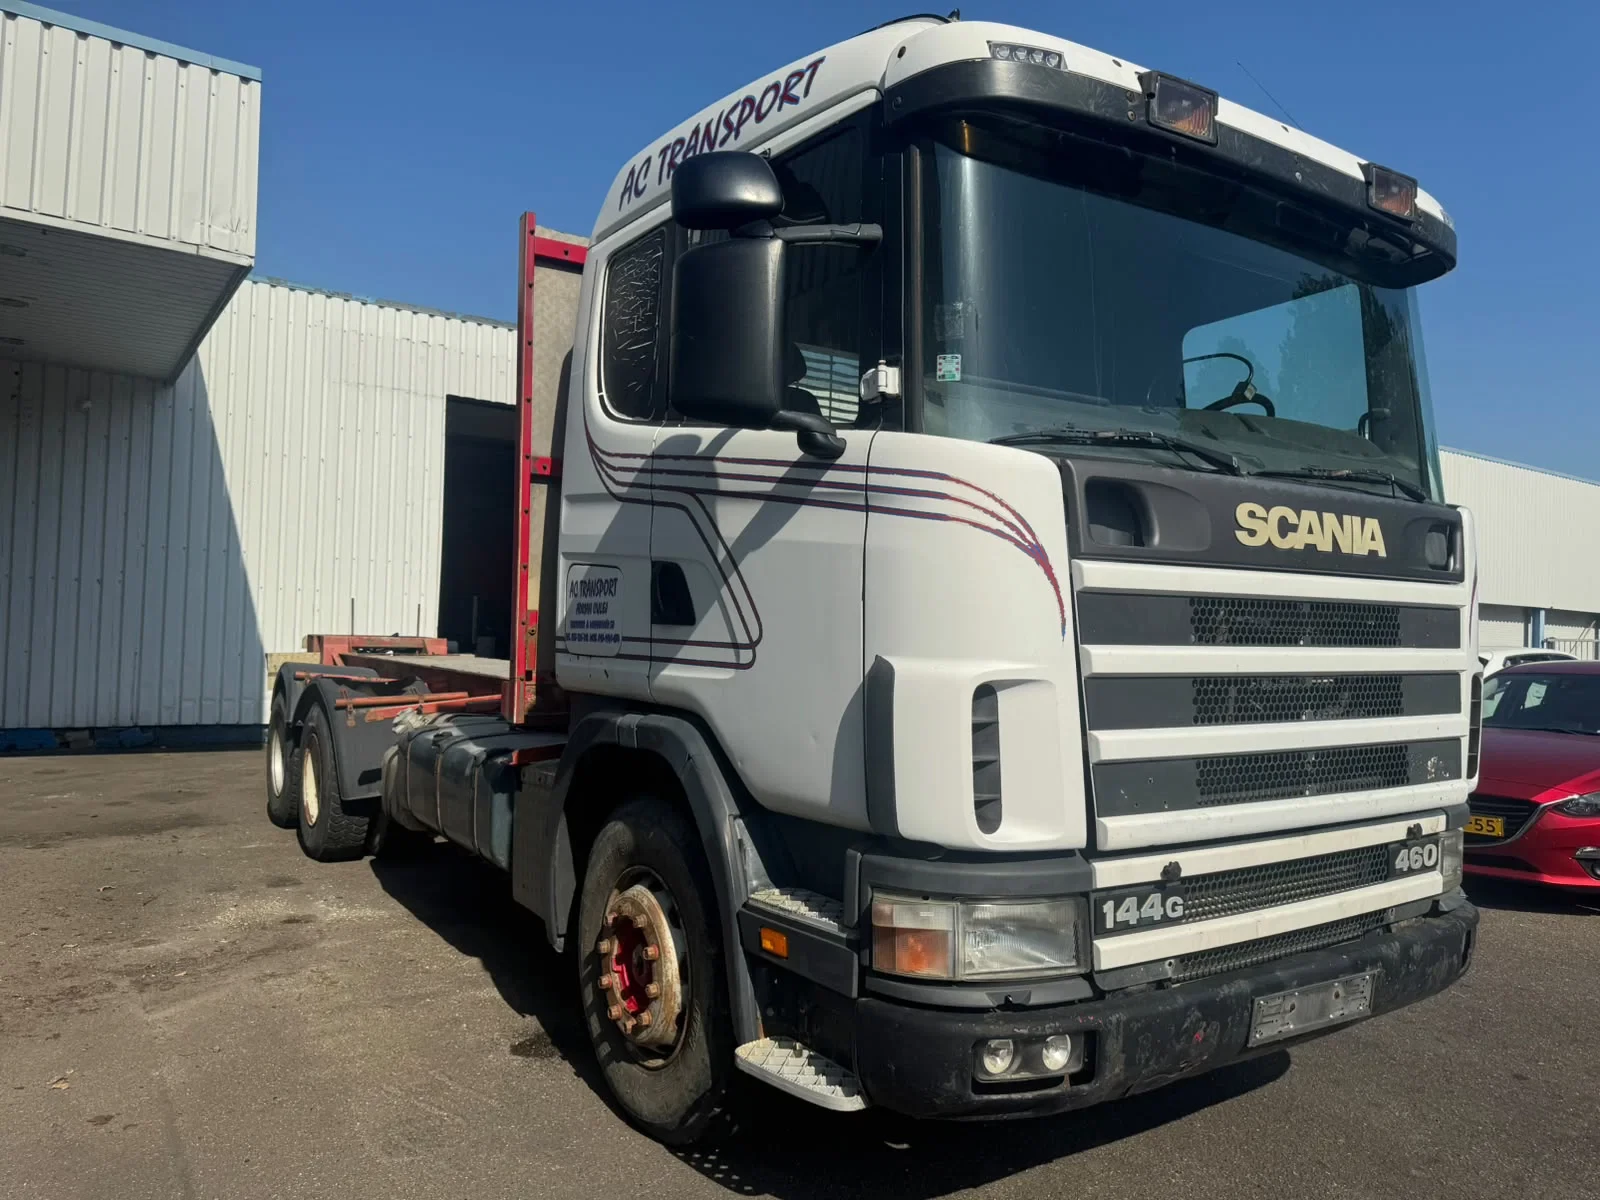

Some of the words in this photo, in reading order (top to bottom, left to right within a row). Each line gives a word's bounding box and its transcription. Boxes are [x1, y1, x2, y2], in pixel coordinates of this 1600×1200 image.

[618, 155, 652, 212] AC
[657, 55, 827, 187] TRANSPORT
[1234, 502, 1387, 558] SCANIA
[569, 579, 579, 599] AC
[579, 577, 619, 599] TRANSPORT
[1395, 843, 1438, 872] 460
